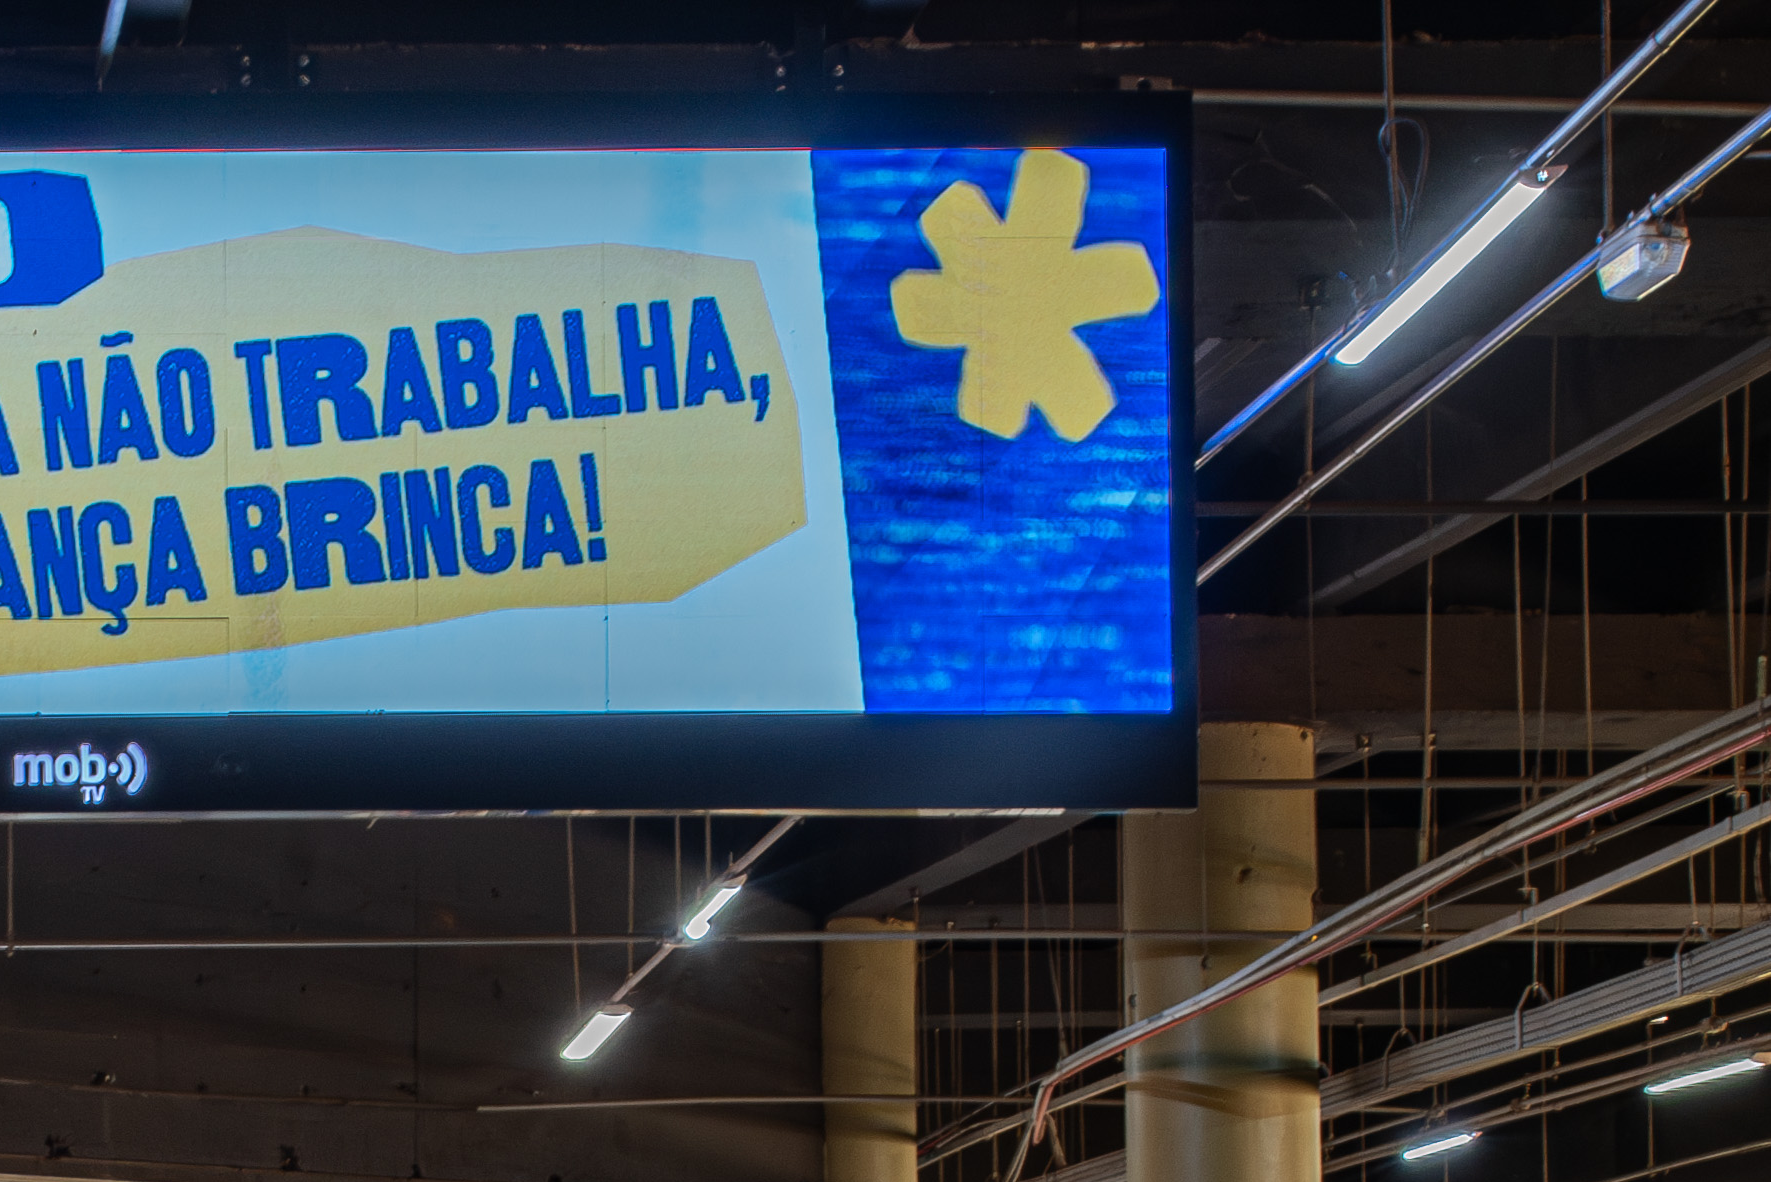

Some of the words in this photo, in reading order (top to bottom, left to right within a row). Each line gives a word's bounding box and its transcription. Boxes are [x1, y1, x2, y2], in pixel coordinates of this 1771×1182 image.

[36, 331, 215, 471] NÃO
[234, 297, 770, 450] TRABALHA,
[225, 453, 607, 598] BRINCA!
[80, 785, 106, 804] TV
